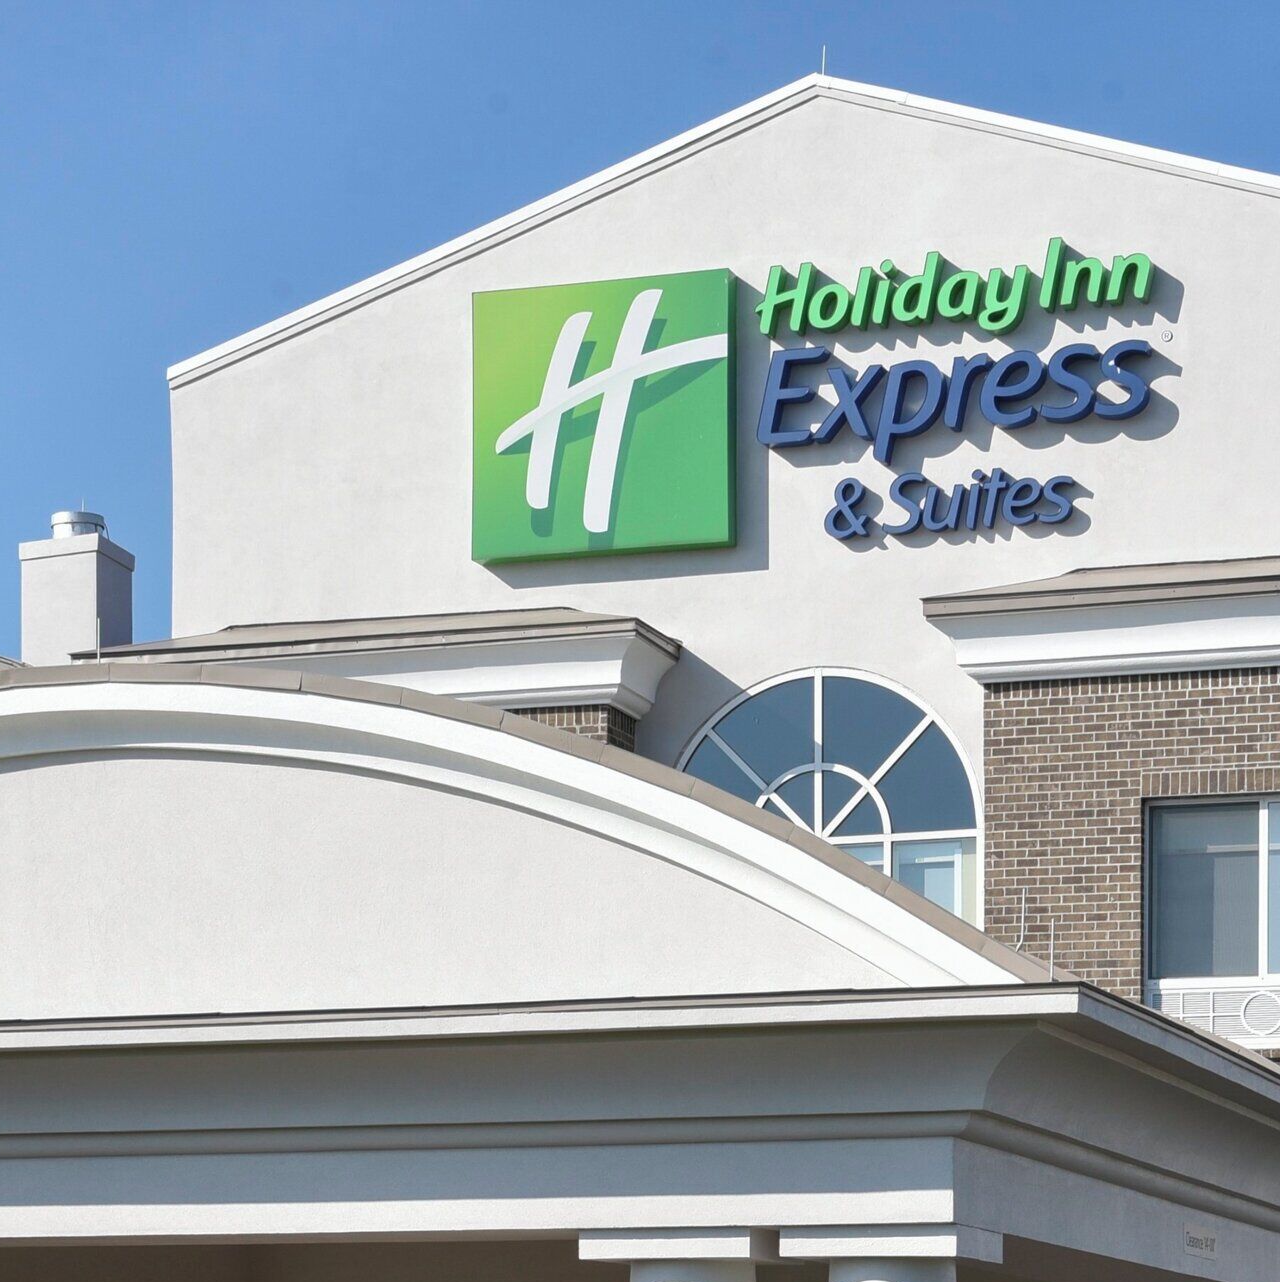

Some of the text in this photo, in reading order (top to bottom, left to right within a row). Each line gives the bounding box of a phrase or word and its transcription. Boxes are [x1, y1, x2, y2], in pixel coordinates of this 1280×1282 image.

[755, 236, 1154, 337] Holiday Inn
[757, 339, 1151, 466] Express
[824, 467, 1074, 540] & Suites
